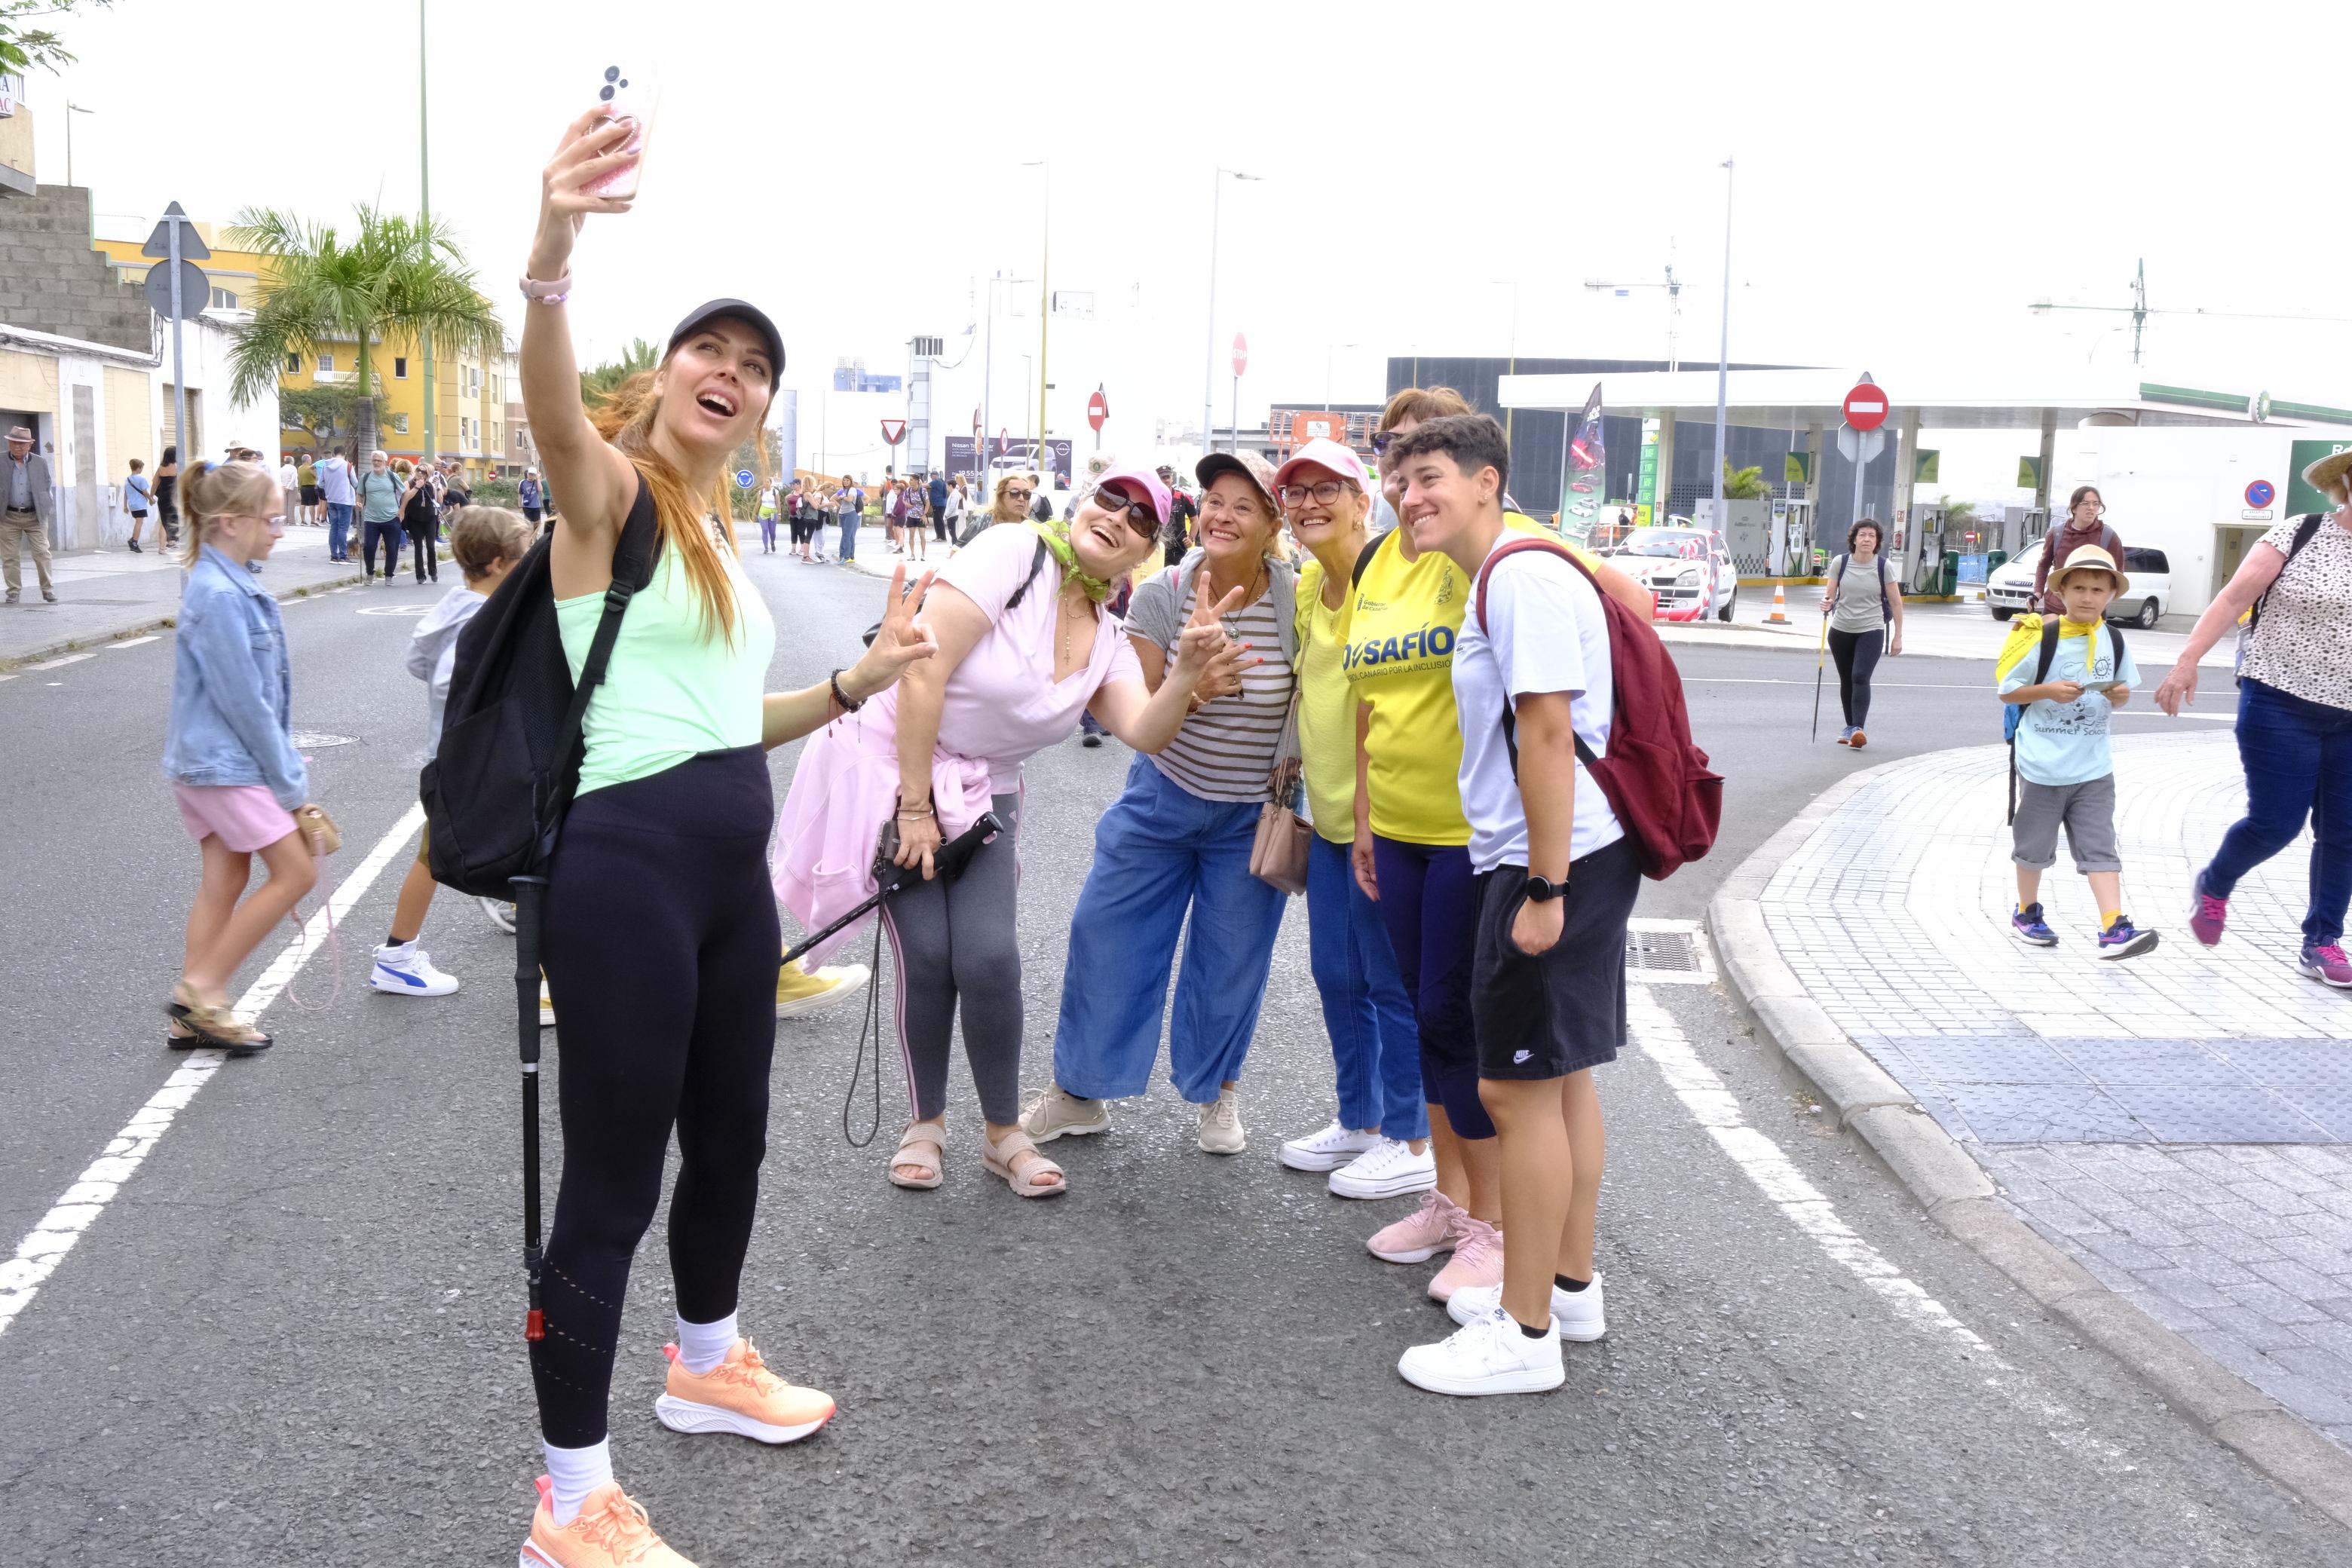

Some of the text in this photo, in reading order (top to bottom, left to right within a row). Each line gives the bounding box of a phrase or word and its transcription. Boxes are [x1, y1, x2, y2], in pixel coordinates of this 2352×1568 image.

[1233, 348, 1247, 360] STOP
[1359, 667, 1388, 680] CANARIO
[1389, 665, 1403, 675] POR
[1404, 663, 1415, 672] LA
[2034, 724, 2081, 735] Summer
